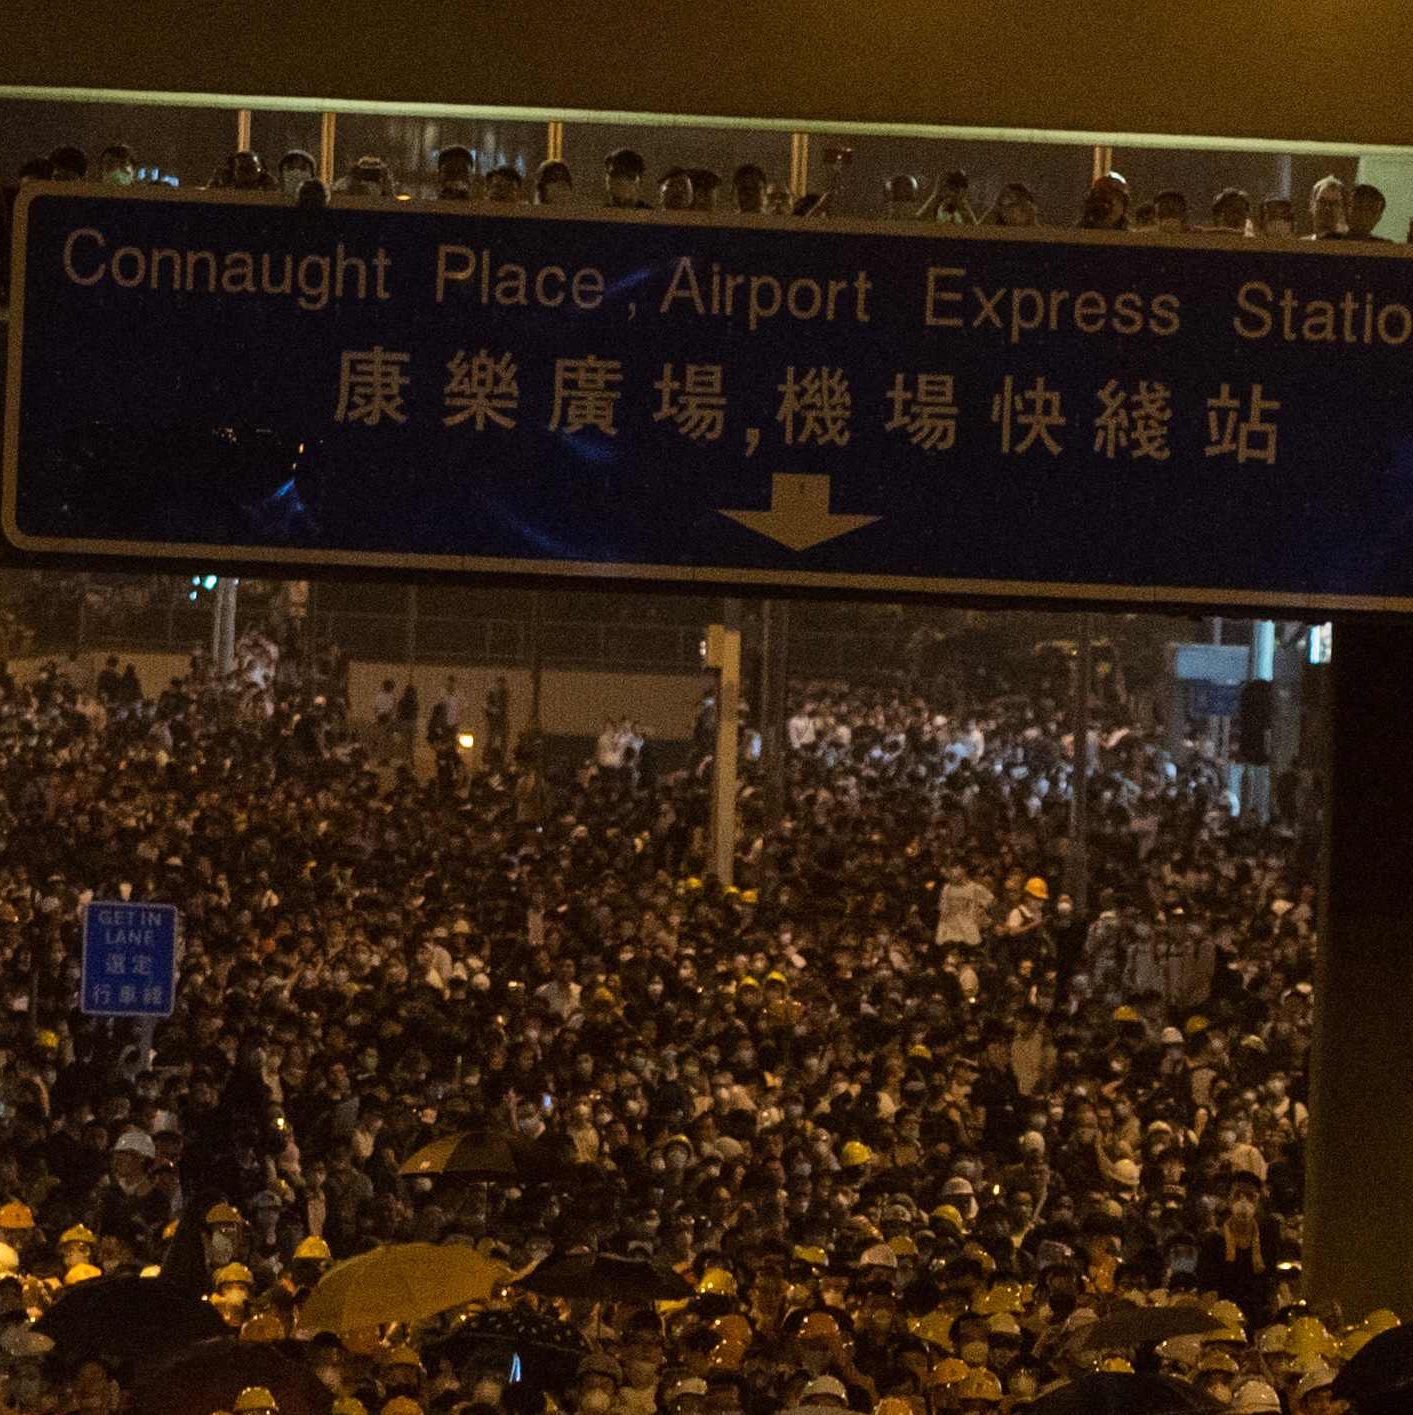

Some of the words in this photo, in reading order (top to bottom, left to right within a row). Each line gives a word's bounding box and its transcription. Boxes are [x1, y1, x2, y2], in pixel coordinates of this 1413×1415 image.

[62, 227, 393, 311] Connaught
[660, 255, 872, 331] Airport
[923, 266, 1182, 344] Express
[98, 910, 134, 925] GET
[140, 911, 162, 926] IN
[105, 929, 155, 946] LANE
